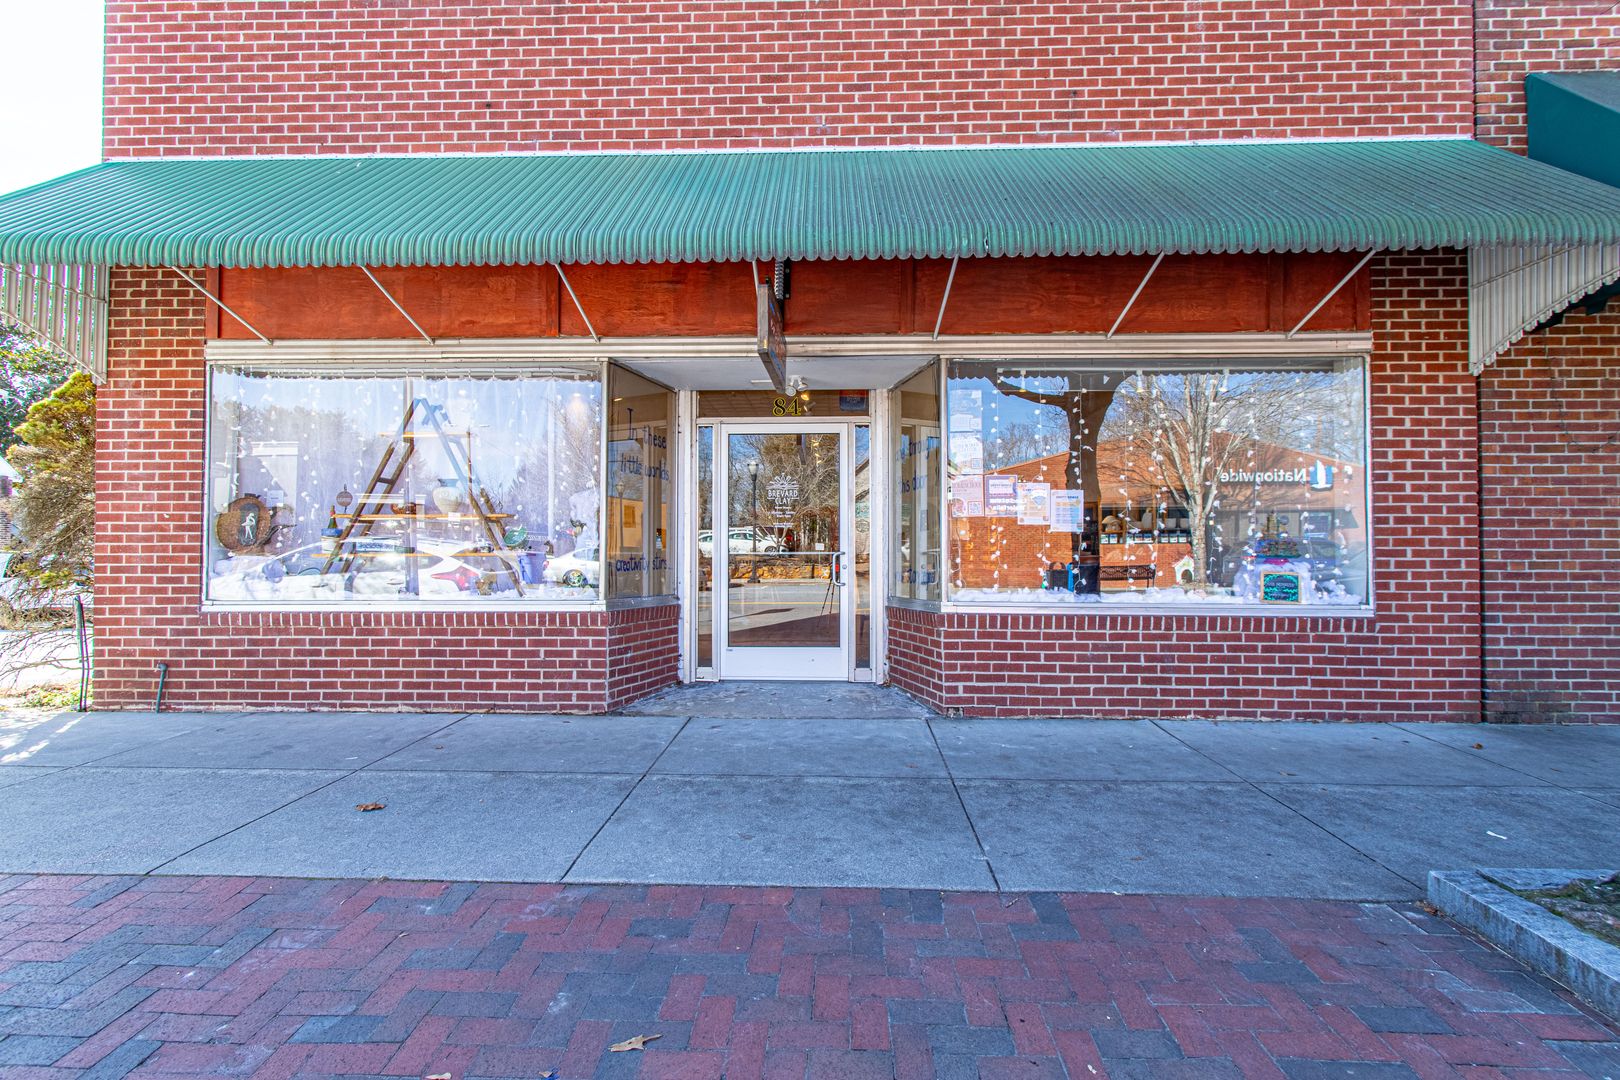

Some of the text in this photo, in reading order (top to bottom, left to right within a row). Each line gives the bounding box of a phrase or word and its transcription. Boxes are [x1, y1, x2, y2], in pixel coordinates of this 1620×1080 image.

[772, 397, 802, 417] 84
[642, 425, 667, 449] these
[768, 489, 798, 498] BREVARD
[775, 497, 791, 505] CLAY
[616, 553, 650, 575] creativity
